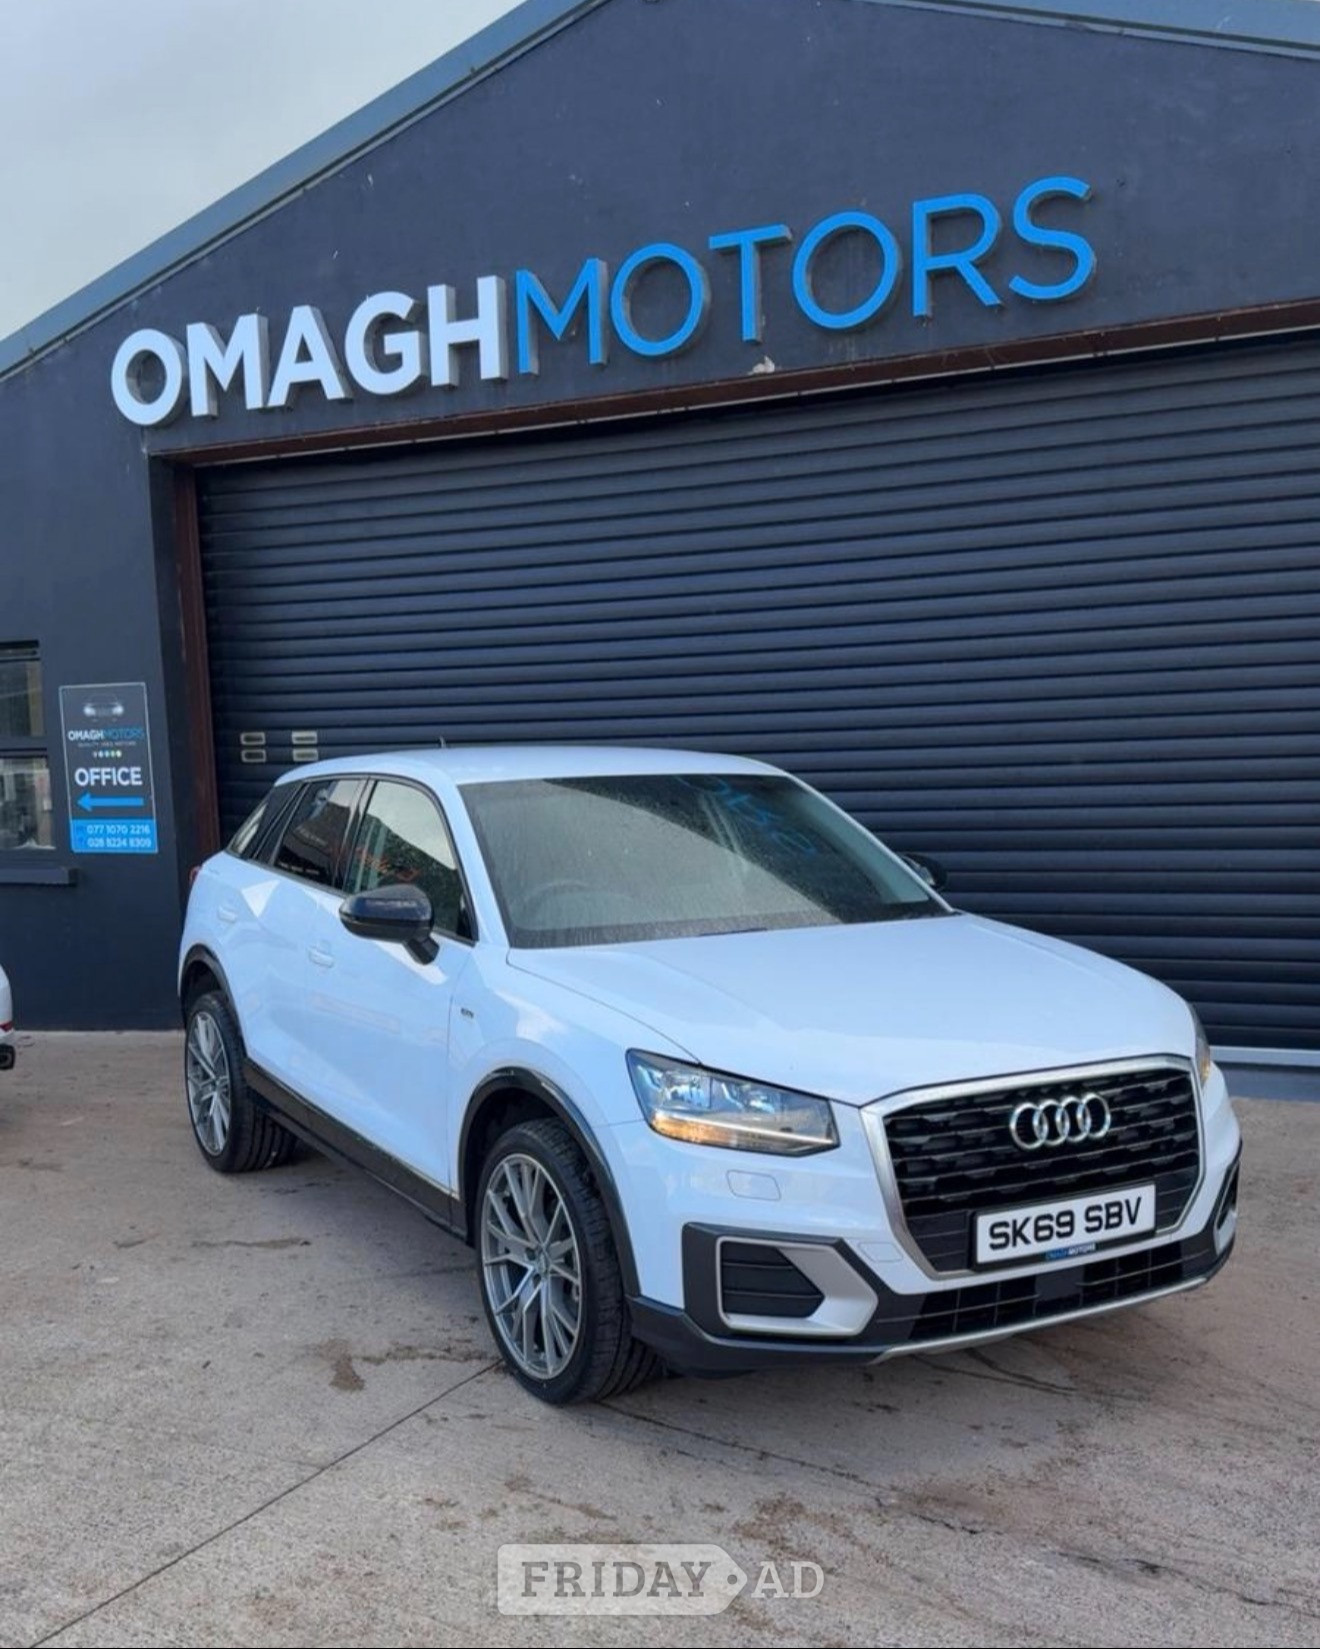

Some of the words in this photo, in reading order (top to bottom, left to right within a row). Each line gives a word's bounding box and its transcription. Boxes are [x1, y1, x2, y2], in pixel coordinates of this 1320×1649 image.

[74, 767, 143, 787] OFFICE
[86, 824, 104, 835] 077
[106, 824, 128, 835] 1070
[130, 824, 151, 835] 2216
[989, 1209, 1075, 1251] SK69
[1084, 1196, 1142, 1234] SBV
